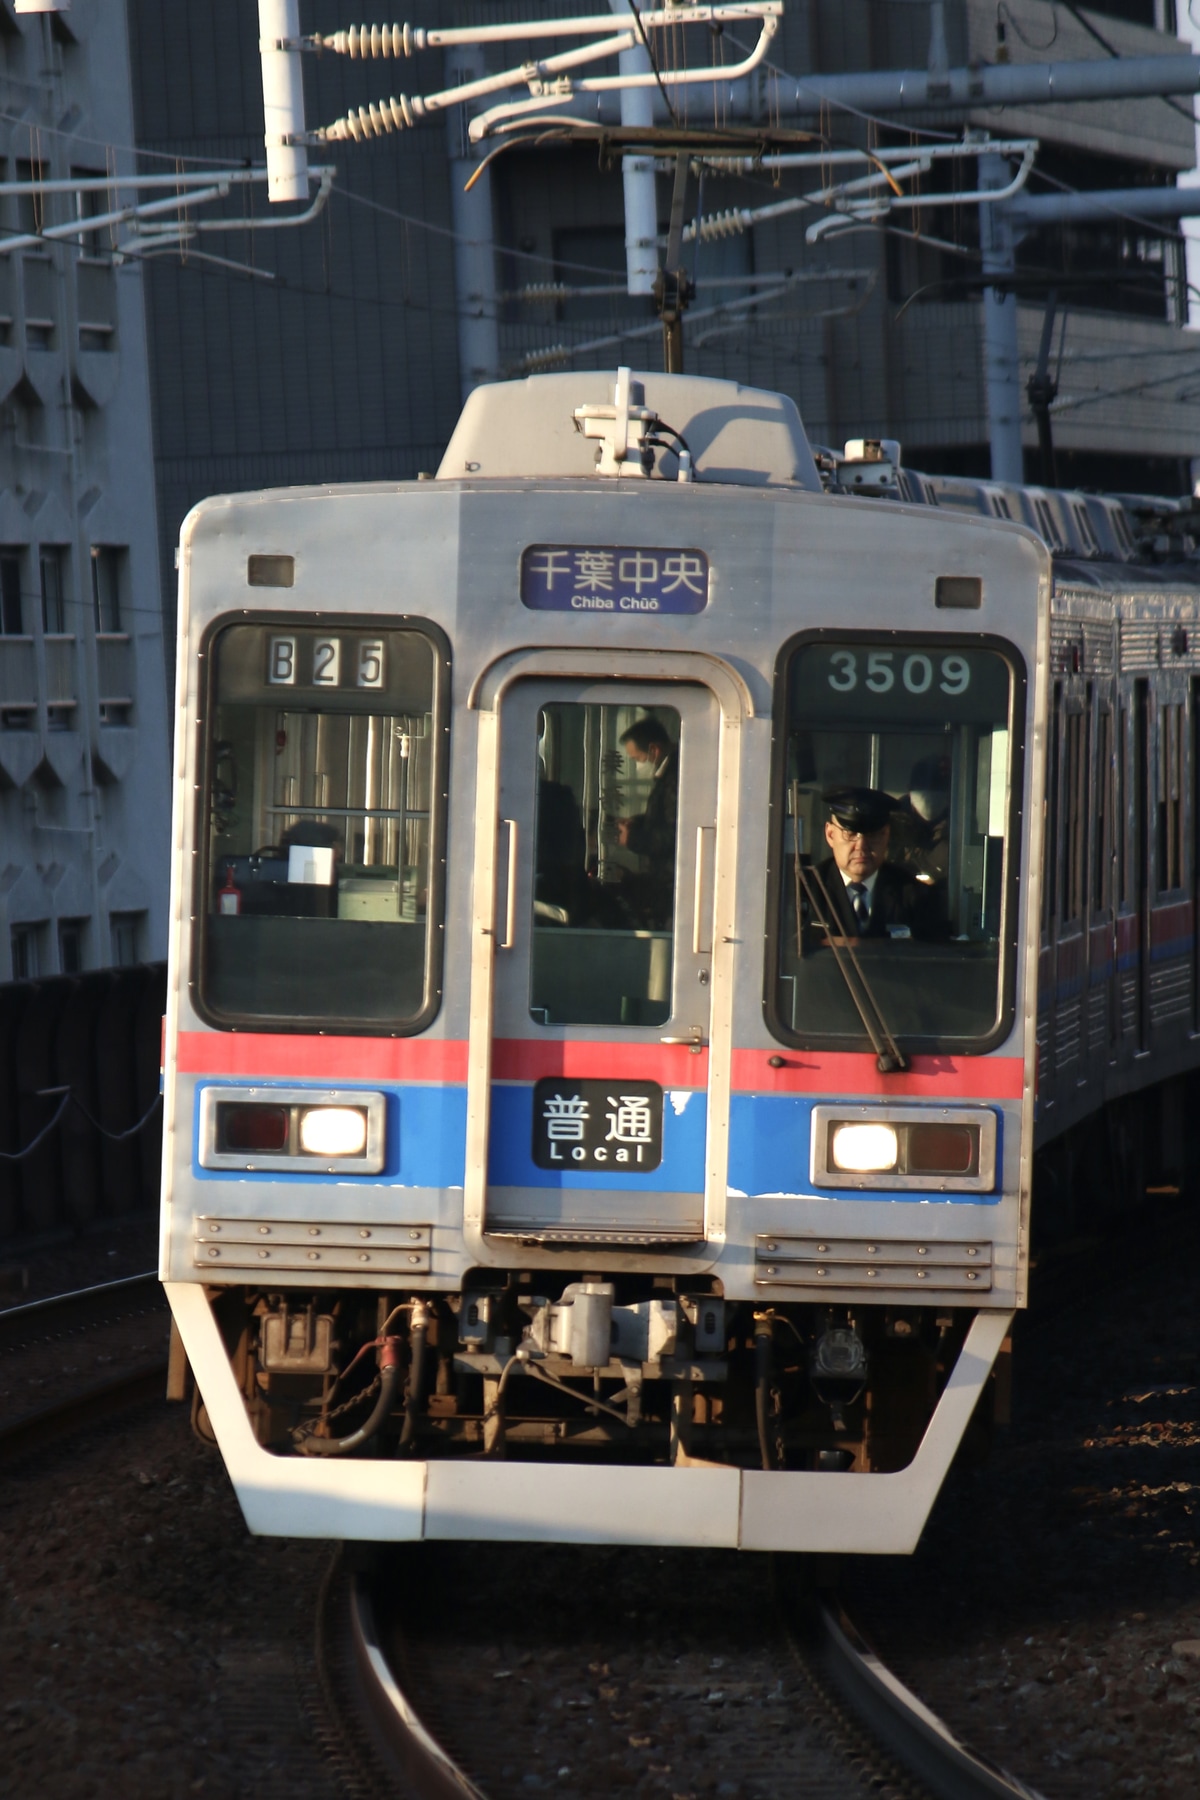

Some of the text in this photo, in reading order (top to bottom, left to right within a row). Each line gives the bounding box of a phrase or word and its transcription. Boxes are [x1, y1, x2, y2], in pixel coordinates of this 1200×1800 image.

[529, 550, 704, 594] 千葉中央
[571, 595, 614, 609] Chiba
[828, 651, 970, 695] 3509
[543, 1094, 652, 1142] 普通
[550, 1142, 643, 1162] Local
